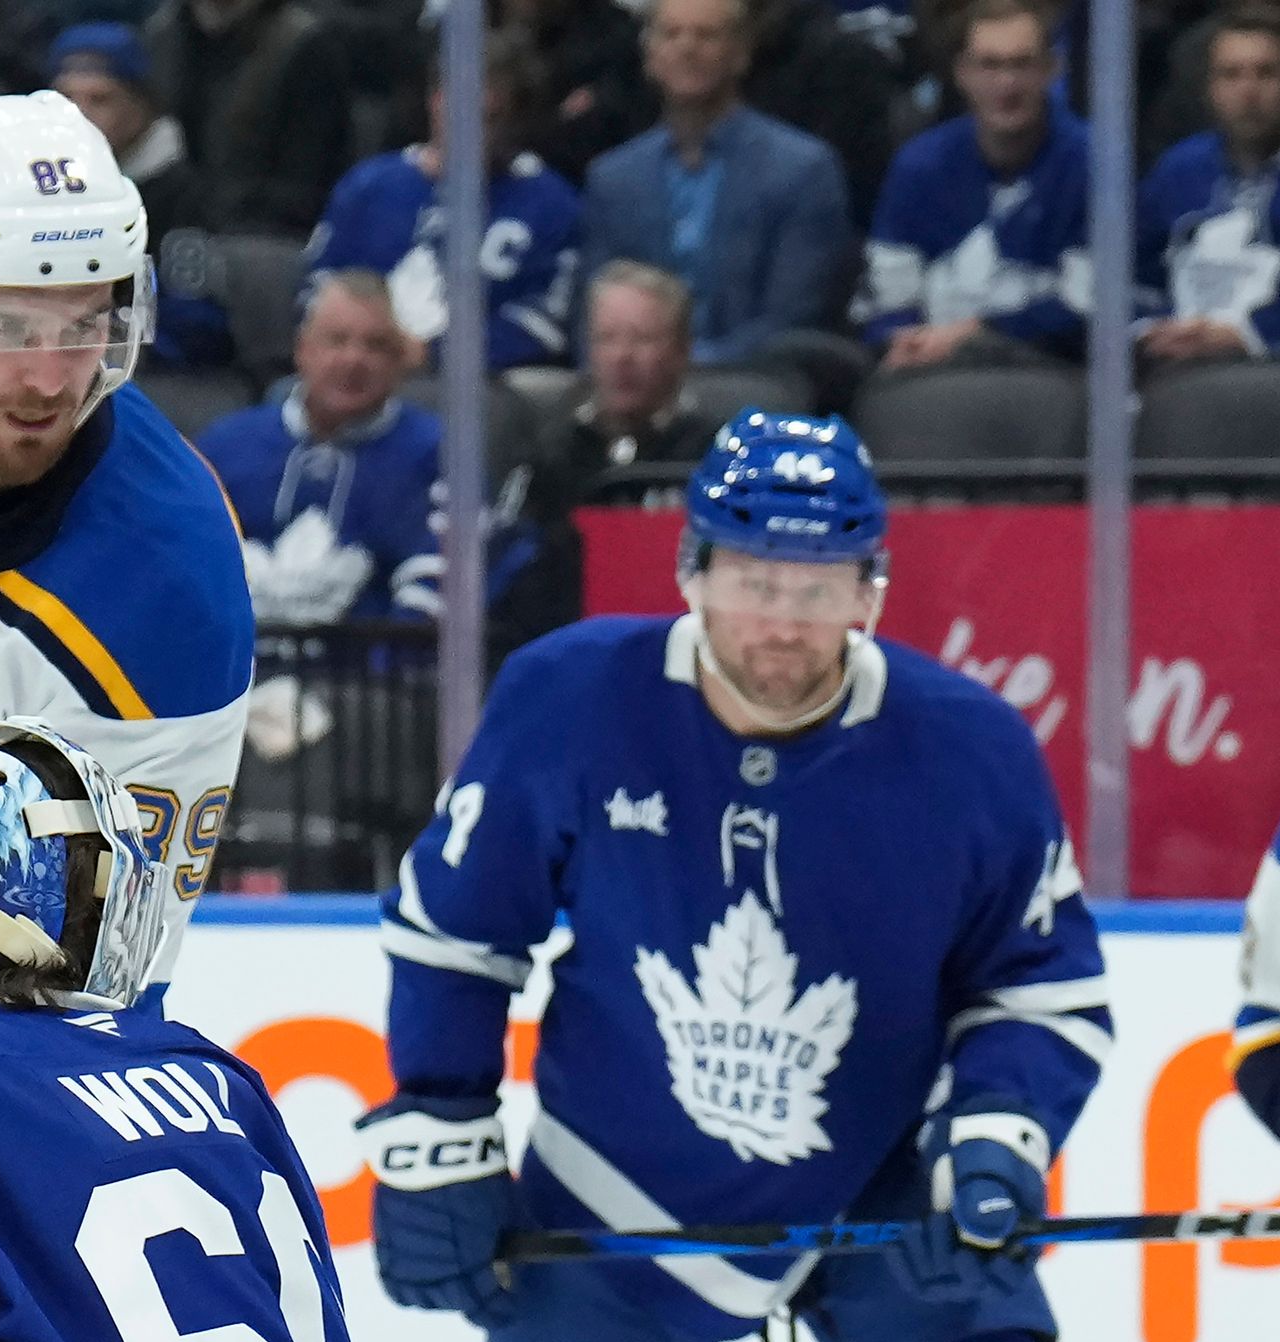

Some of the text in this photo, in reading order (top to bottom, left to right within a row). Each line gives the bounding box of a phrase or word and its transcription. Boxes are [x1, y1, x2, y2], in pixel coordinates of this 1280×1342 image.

[31, 227, 104, 242] BAUER
[480, 218, 532, 281] C
[673, 1021, 819, 1070] TORONTO
[693, 1054, 792, 1091] MAPLE
[692, 1077, 788, 1121] LEAFS
